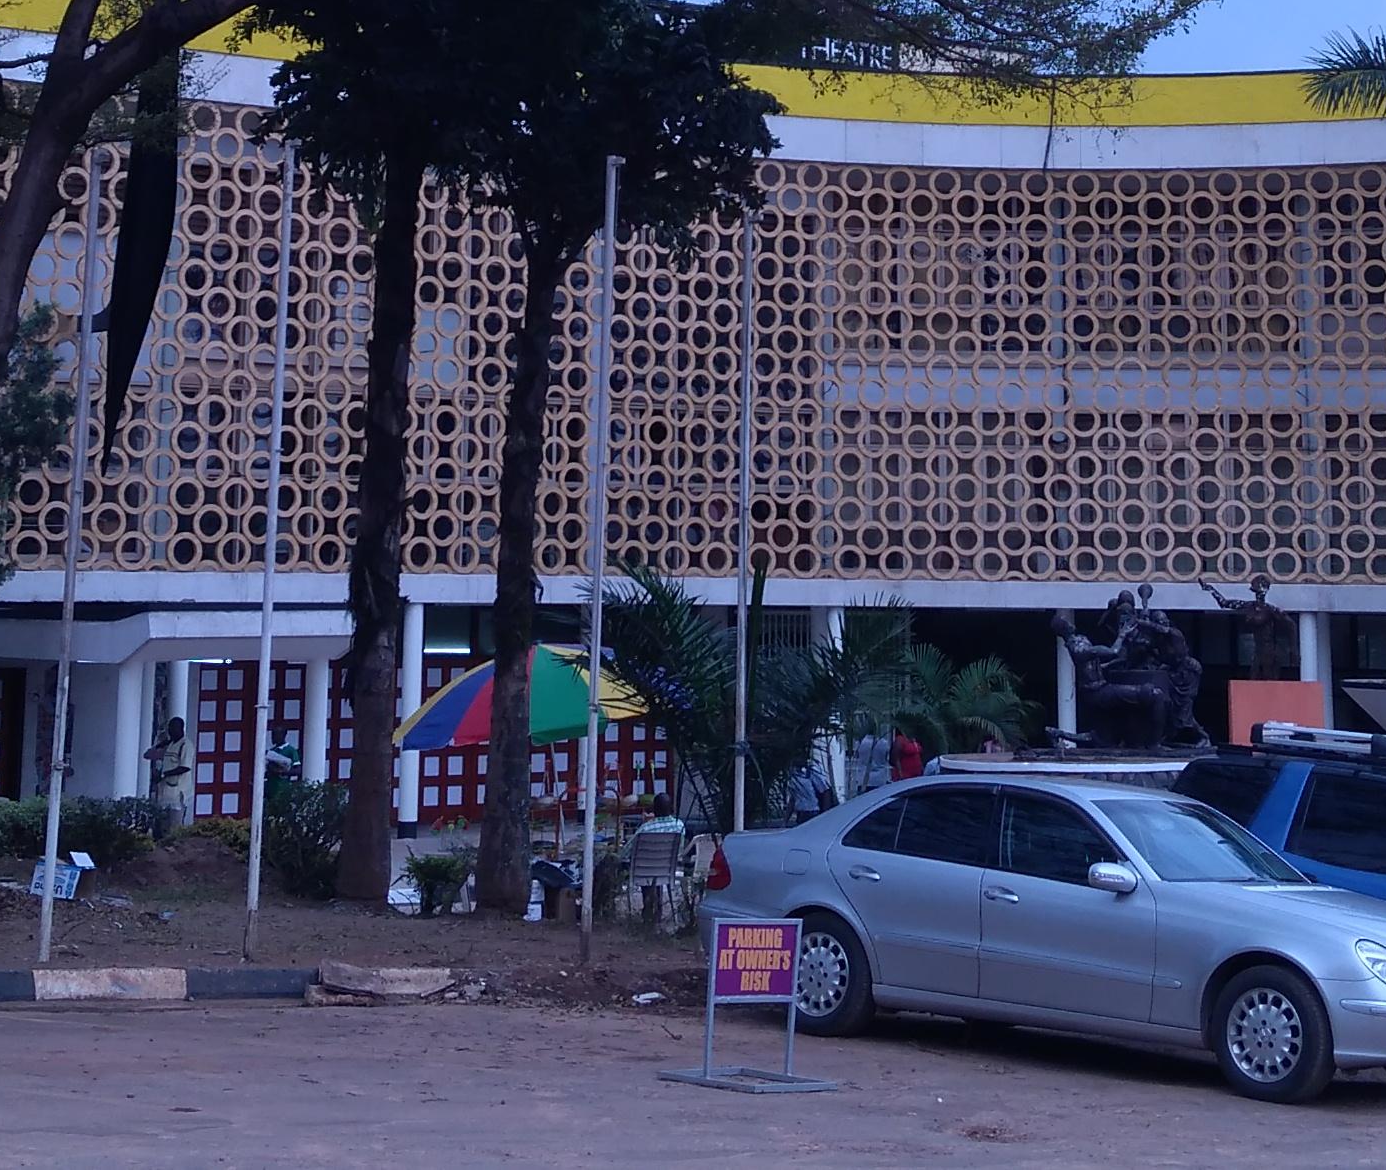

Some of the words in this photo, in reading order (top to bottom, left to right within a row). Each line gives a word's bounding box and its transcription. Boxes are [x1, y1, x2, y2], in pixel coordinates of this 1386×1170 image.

[728, 927, 783, 949] PARKING
[718, 949, 735, 970] AT
[736, 949, 791, 971] OWNER'S
[740, 971, 771, 992] RISK
